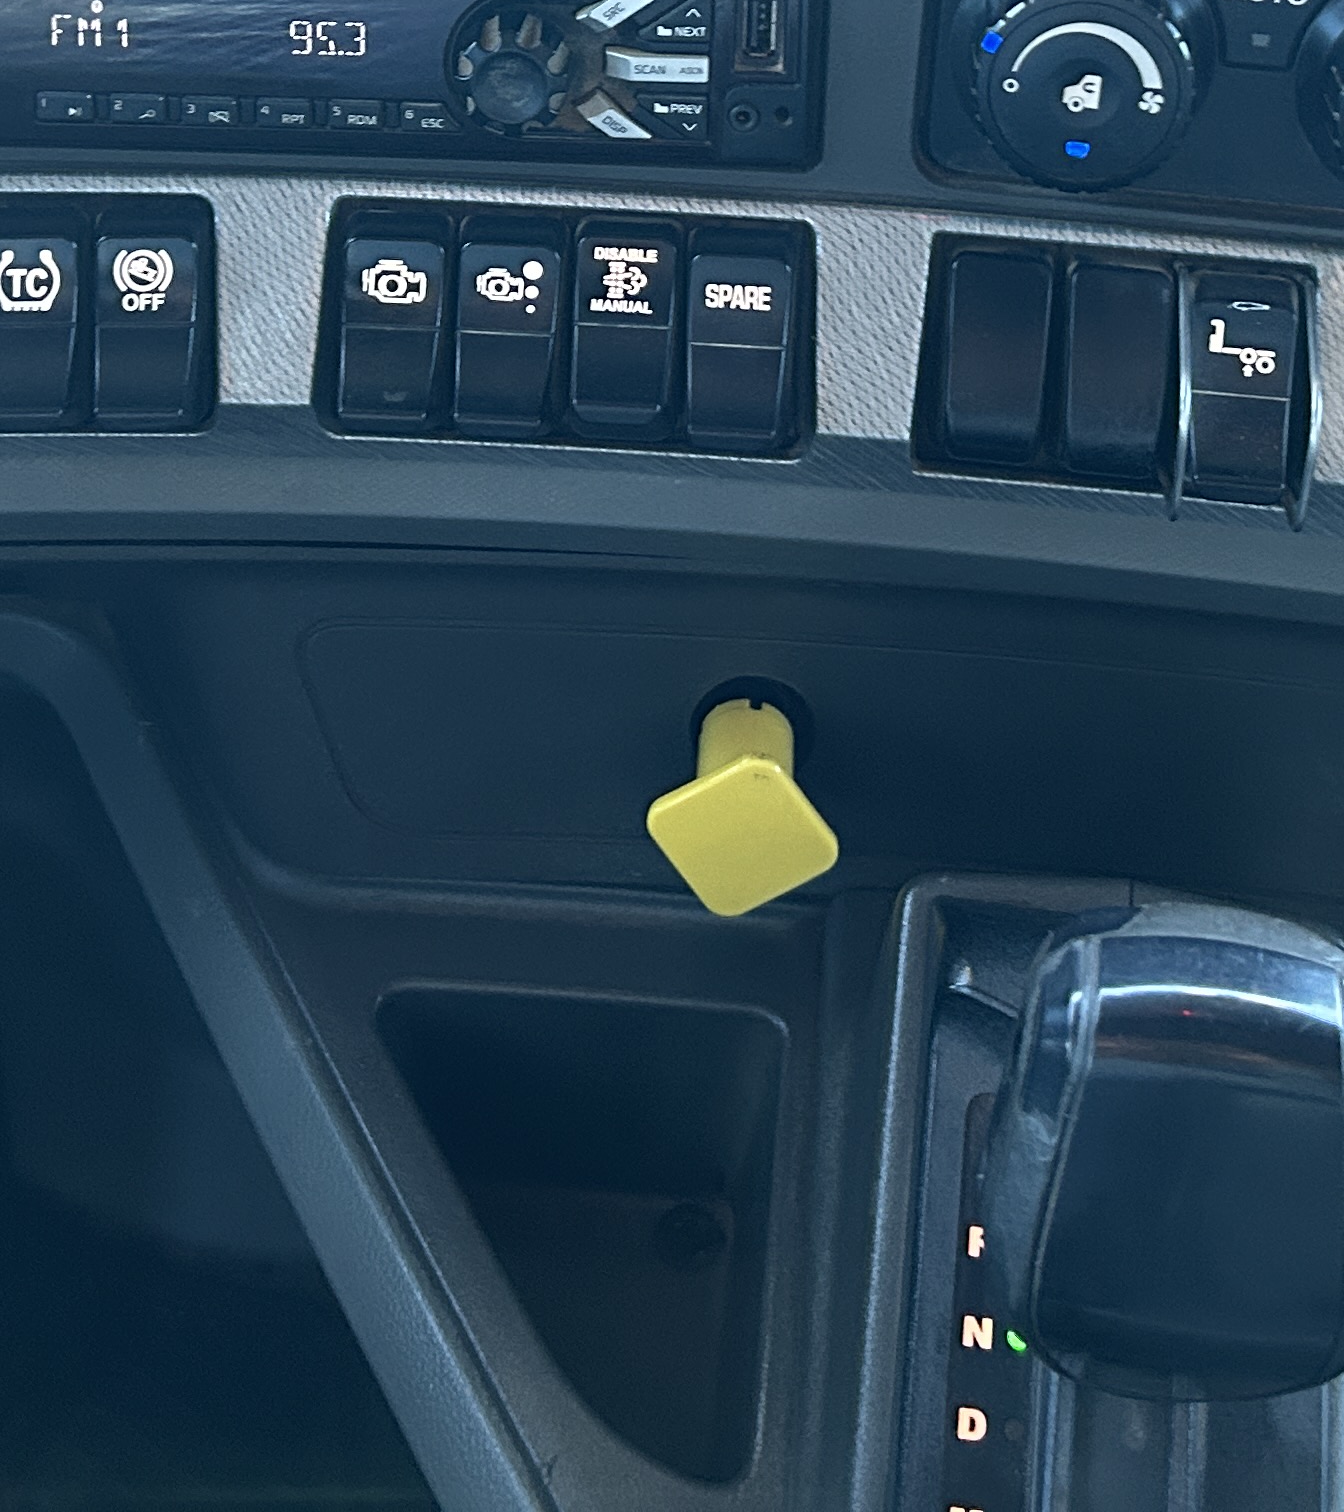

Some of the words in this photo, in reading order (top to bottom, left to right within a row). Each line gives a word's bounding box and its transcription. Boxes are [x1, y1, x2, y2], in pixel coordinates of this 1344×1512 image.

[673, 25, 707, 37] NEXT
[633, 64, 668, 76] SCAN
[669, 103, 704, 115] PREV
[346, 114, 379, 126] RDM
[420, 118, 446, 129] ESC
[601, 115, 629, 134] DISP
[593, 246, 659, 264] DISABLE
[5, 267, 50, 299] TC
[121, 292, 167, 312] OFF
[589, 298, 654, 315] MANUAL
[704, 283, 773, 312] SPARE
[961, 1314, 994, 1350] N
[956, 1406, 988, 1441] D
